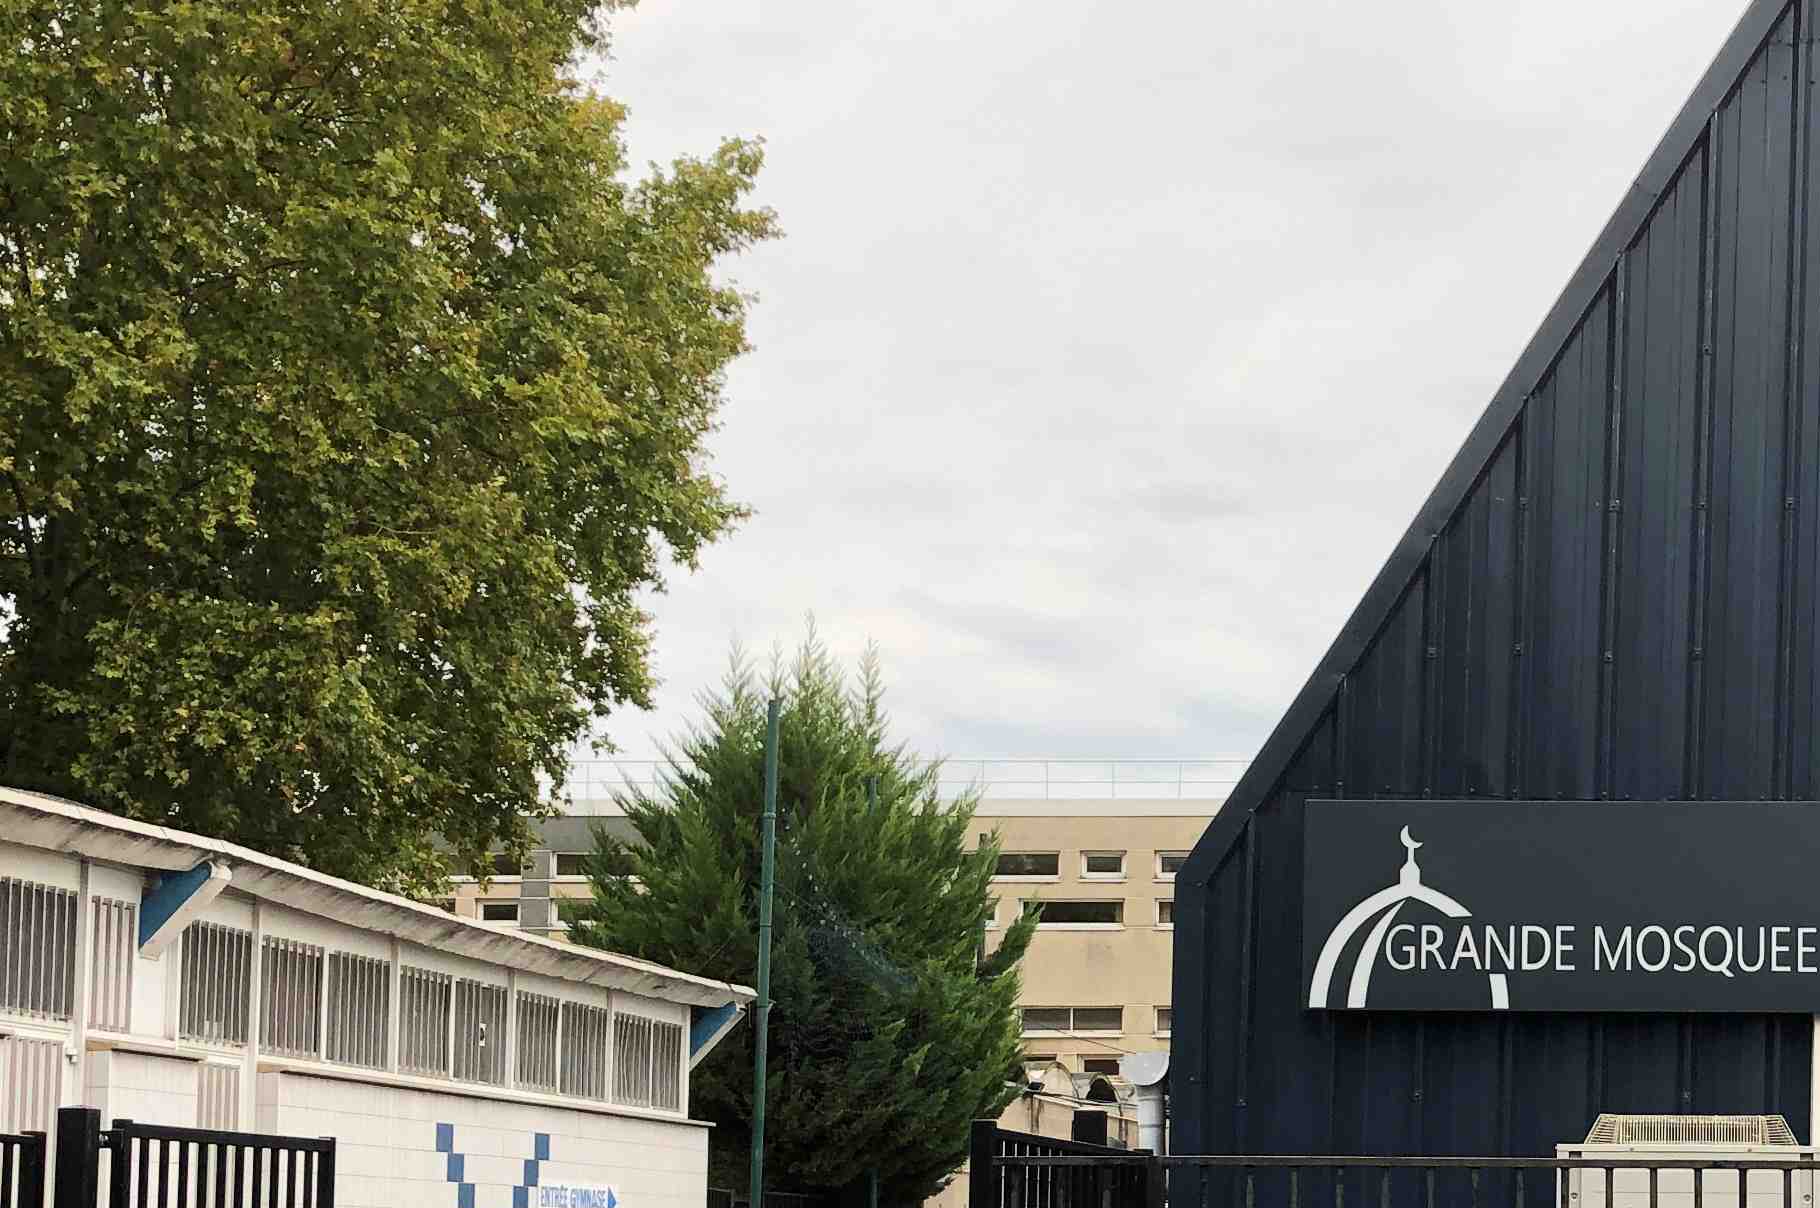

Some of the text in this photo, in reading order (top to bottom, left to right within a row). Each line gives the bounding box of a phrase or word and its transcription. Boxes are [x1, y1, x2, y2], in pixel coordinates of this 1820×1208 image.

[1385, 924, 1576, 971] GRANDE
[1594, 925, 1818, 978] MOSQUEE
[540, 1184, 568, 1208] ENTRÉE
